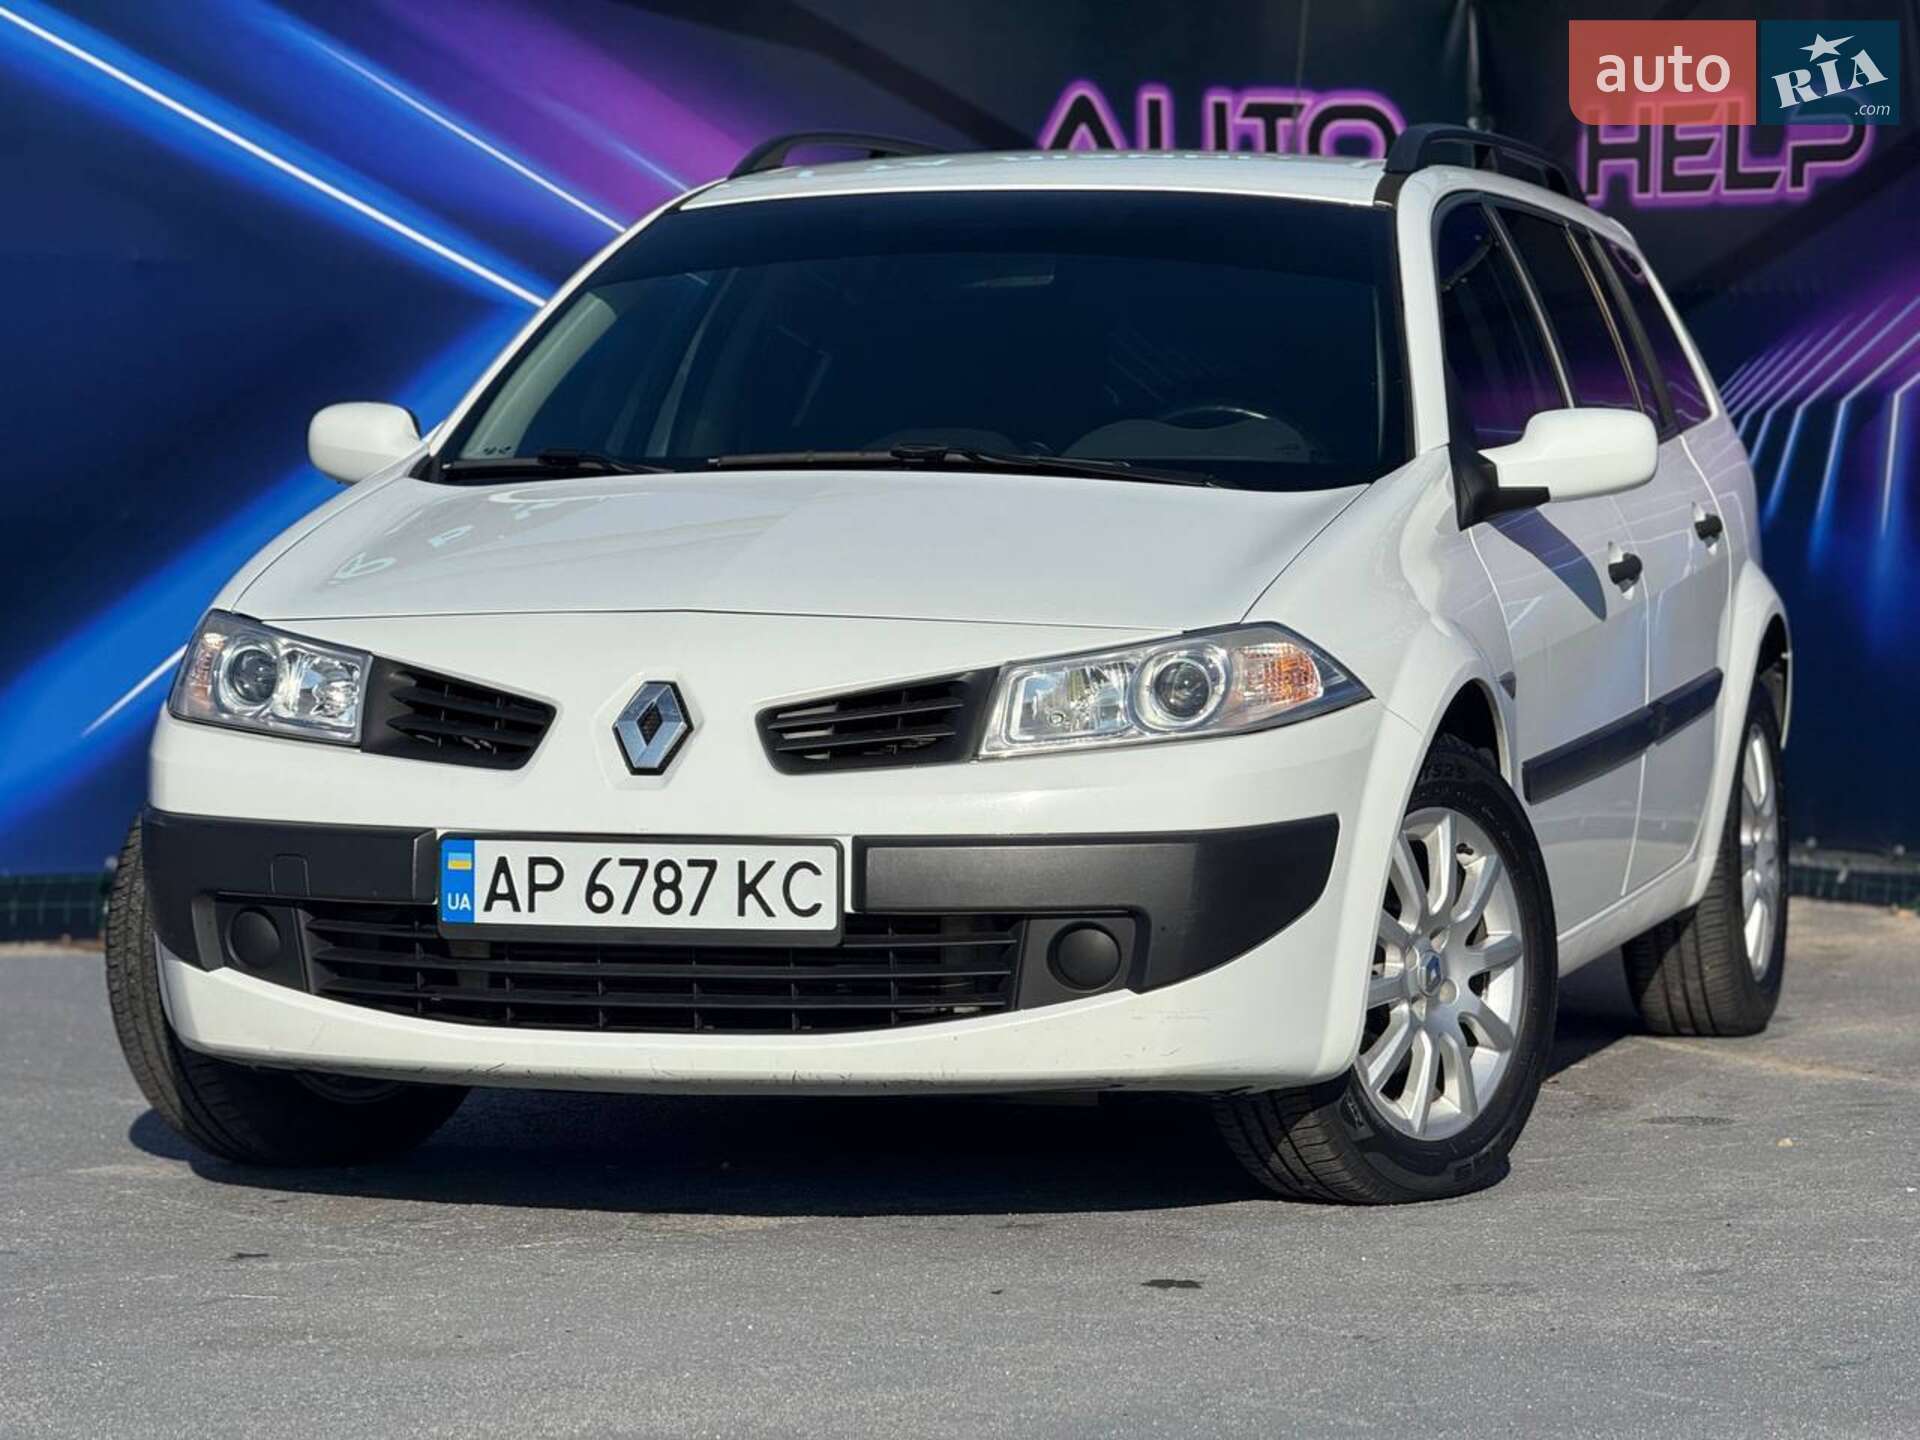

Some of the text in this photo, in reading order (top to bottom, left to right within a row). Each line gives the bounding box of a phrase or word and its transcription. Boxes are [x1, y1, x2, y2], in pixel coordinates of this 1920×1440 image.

[1578, 96, 1872, 201] HELP
[447, 892, 471, 911] UA
[483, 855, 823, 918] AP 6787 KC
